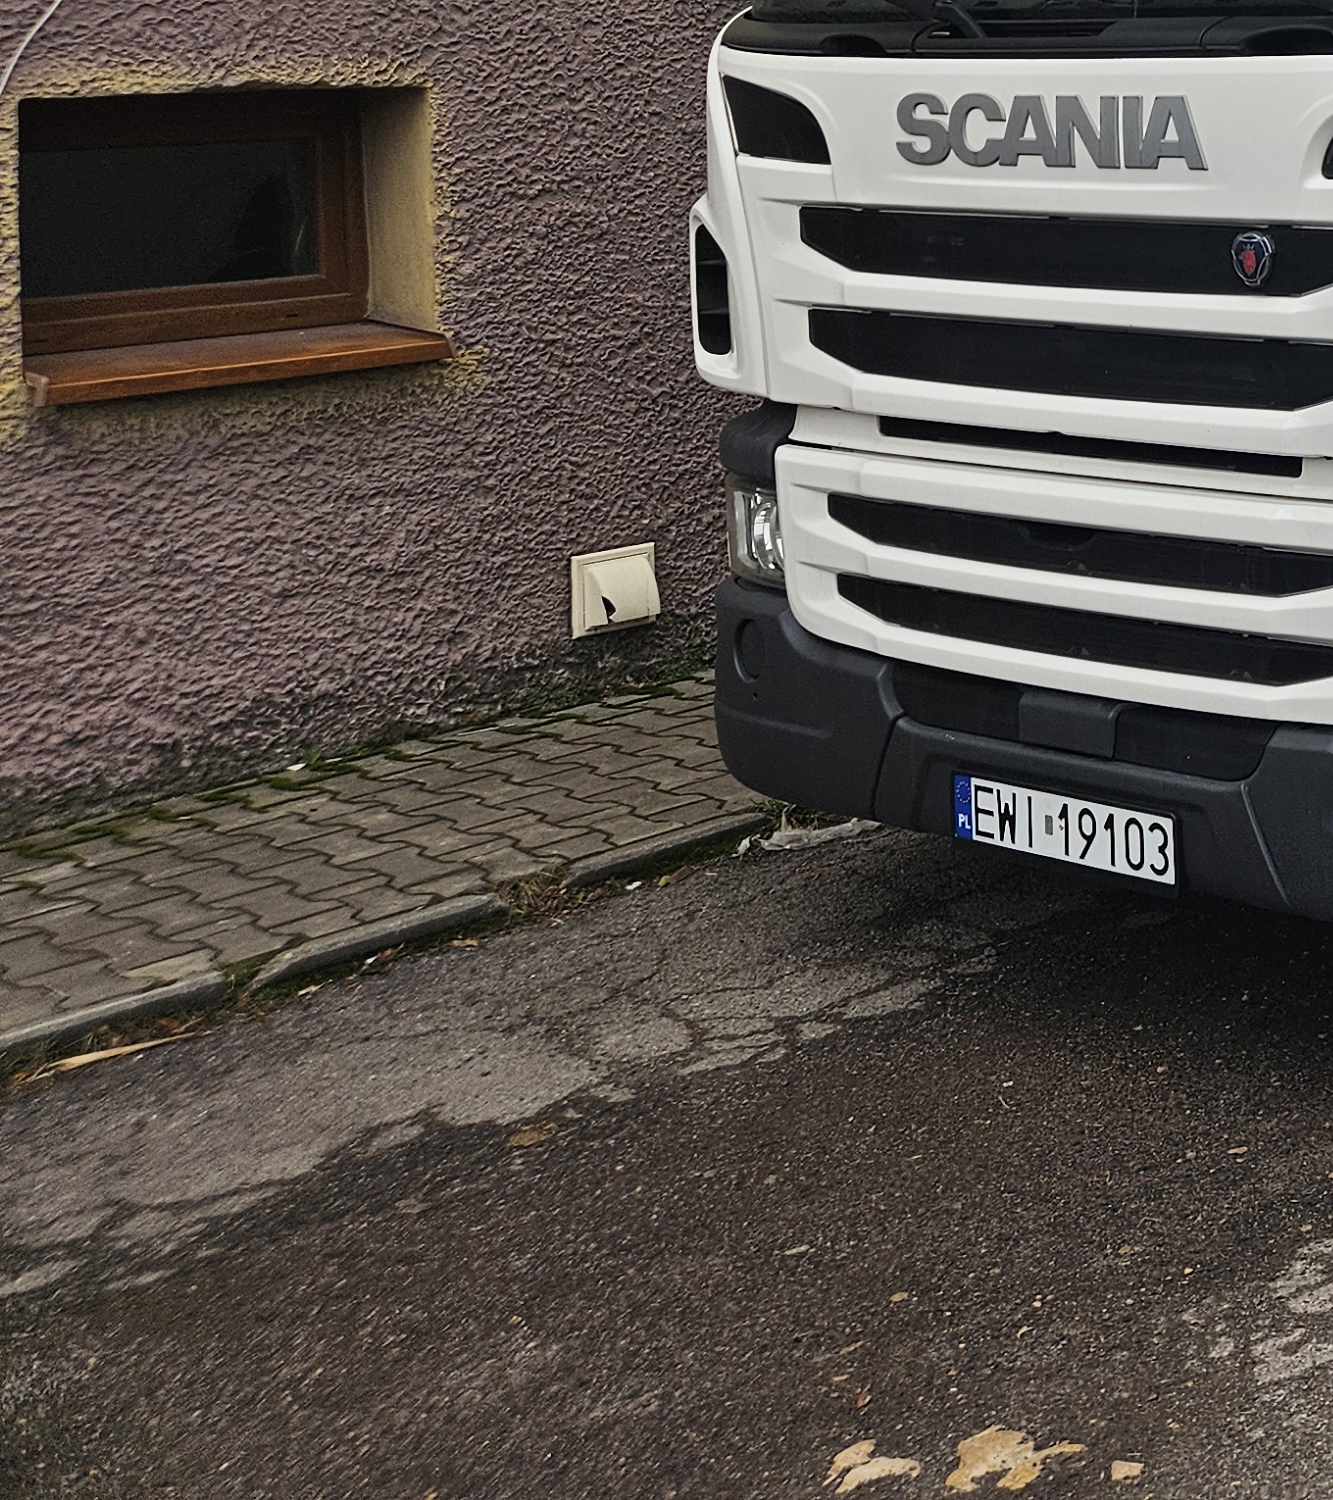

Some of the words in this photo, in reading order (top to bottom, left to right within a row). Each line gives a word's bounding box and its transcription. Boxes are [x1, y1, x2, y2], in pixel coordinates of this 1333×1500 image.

[896, 91, 1208, 171] SCANIA
[958, 813, 971, 830] PL
[974, 785, 1033, 848] EWI
[1058, 803, 1169, 876] 19103
